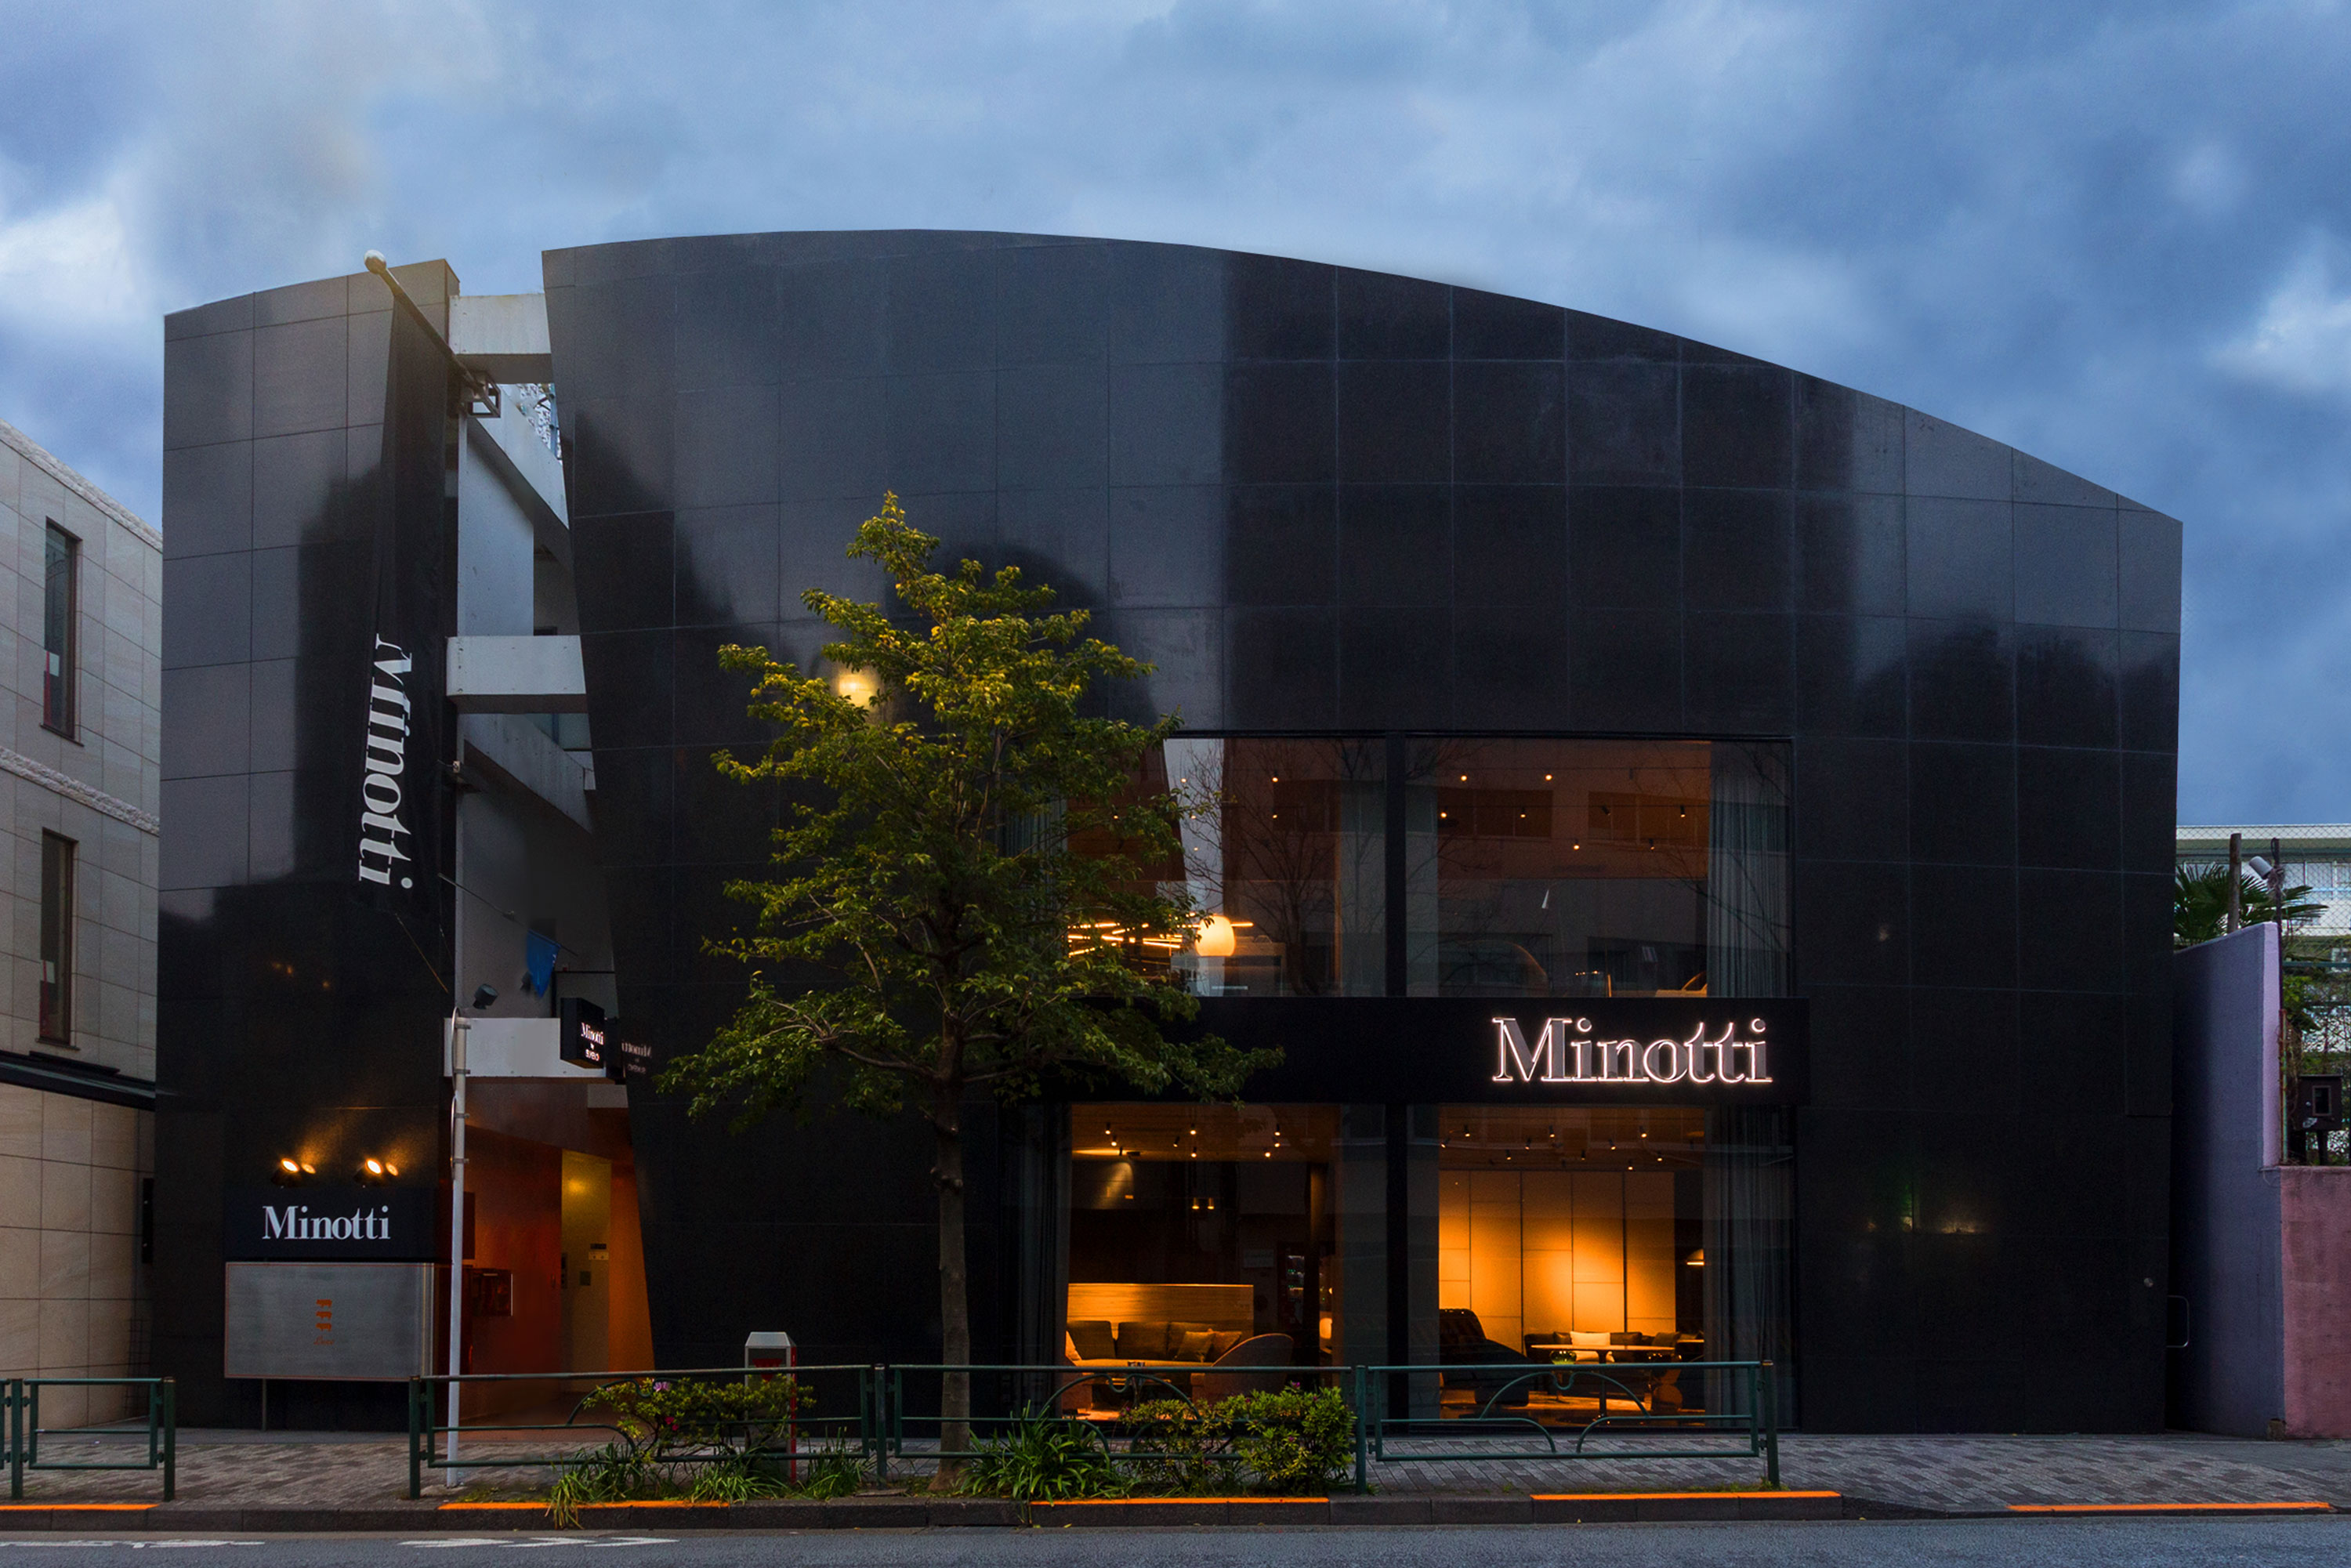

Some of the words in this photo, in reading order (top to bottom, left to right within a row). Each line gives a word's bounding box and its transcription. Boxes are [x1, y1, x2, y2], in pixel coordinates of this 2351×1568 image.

[358, 632, 414, 889] Minotti
[1491, 1016, 1773, 1084] Minotti
[261, 1204, 391, 1240] Minotti
